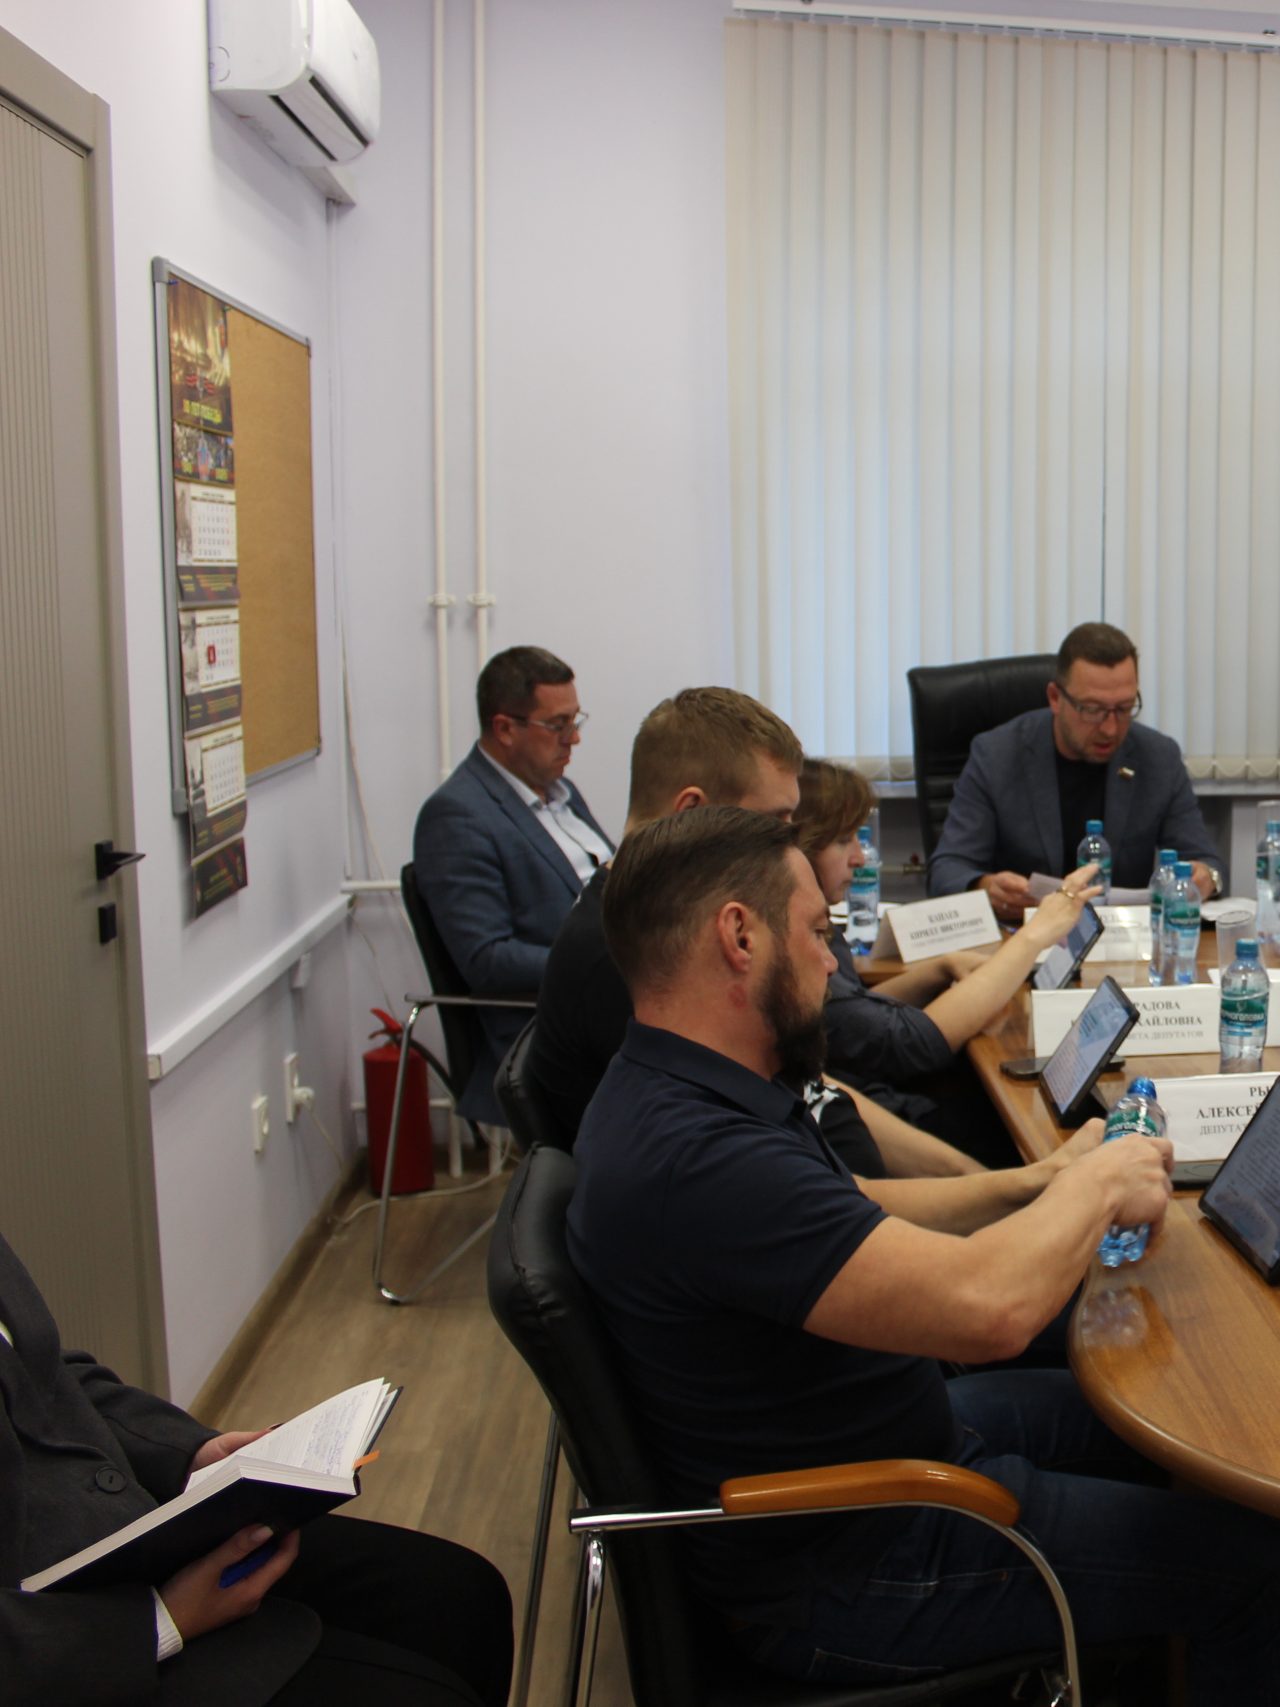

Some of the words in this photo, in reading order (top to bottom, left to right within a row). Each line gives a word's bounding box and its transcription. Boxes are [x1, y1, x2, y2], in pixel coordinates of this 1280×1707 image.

[1134, 1001, 1181, 1011] РАДОВА
[1137, 1016, 1203, 1027] ХАЙЛОВНА
[1196, 1102, 1261, 1119] АЛЕКСЕ
[1199, 1123, 1245, 1136] ДЕПУТА
